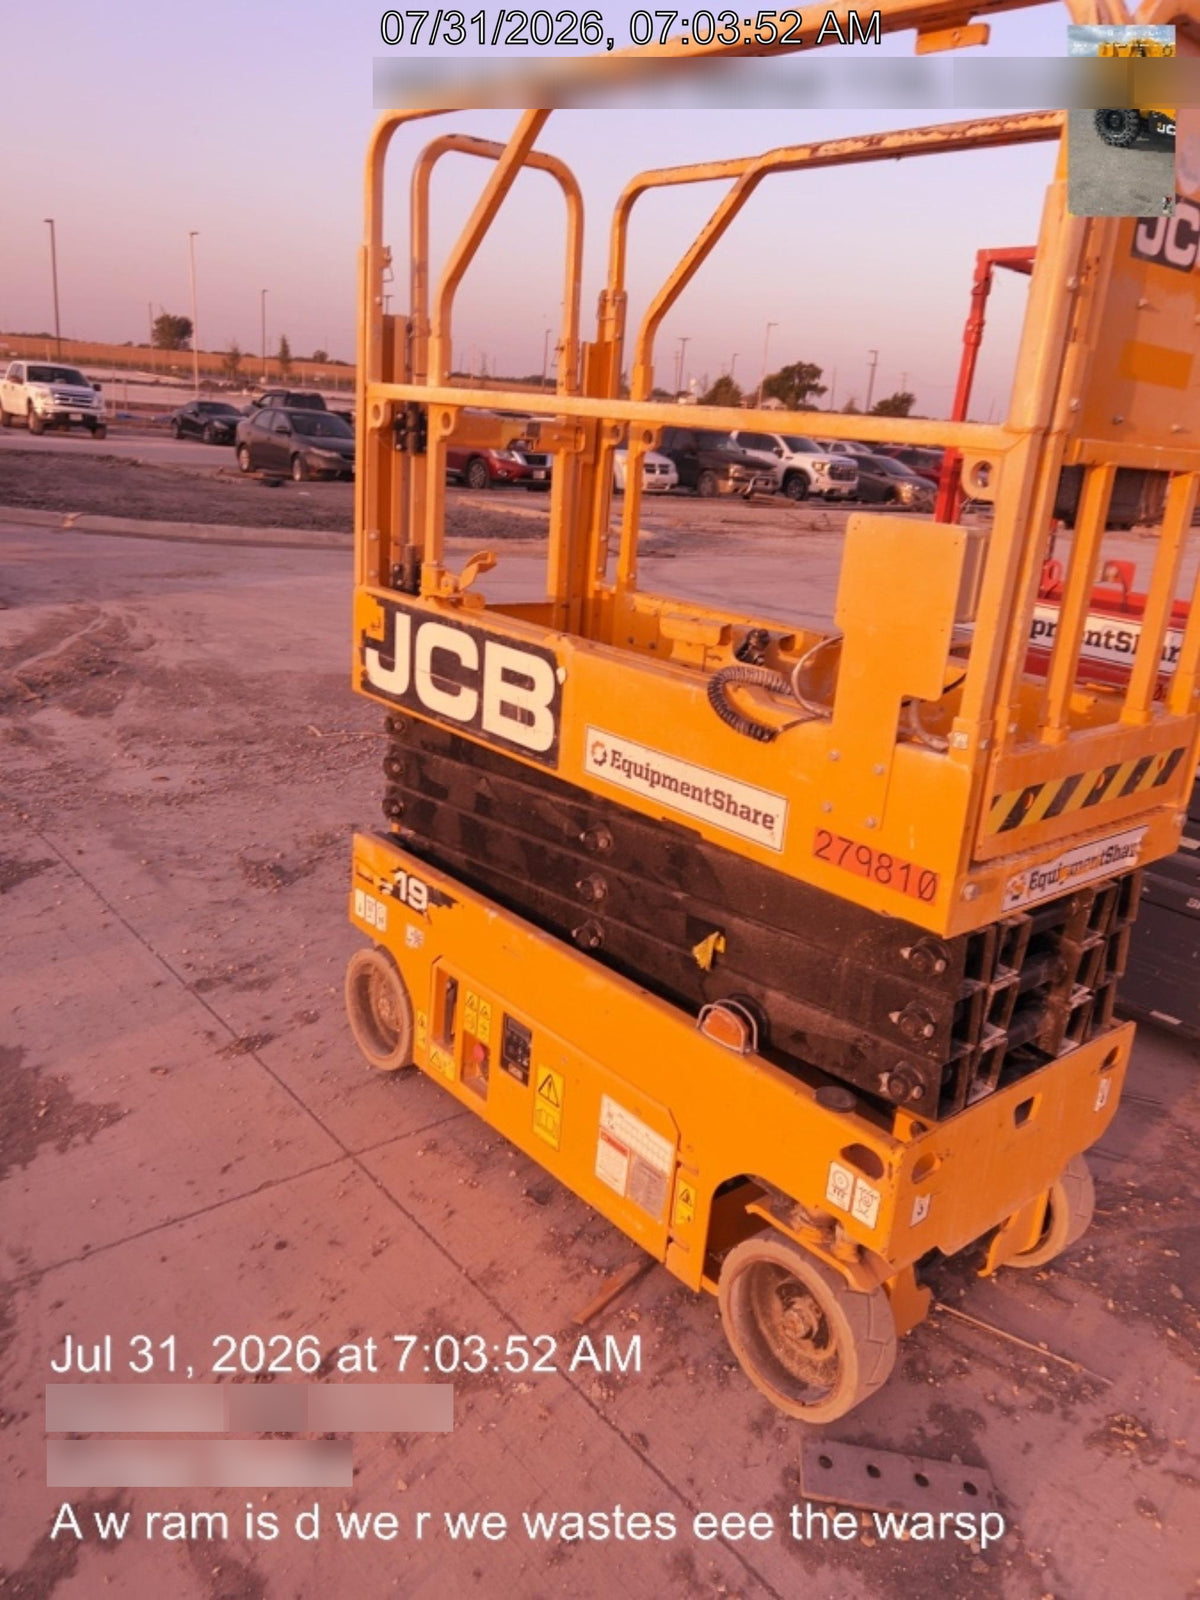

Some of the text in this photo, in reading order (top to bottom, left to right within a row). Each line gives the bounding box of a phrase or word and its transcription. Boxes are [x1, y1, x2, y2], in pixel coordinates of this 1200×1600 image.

[365, 611, 555, 752] JCB
[611, 749, 775, 830] EquipmentShare
[814, 829, 938, 902] 279810
